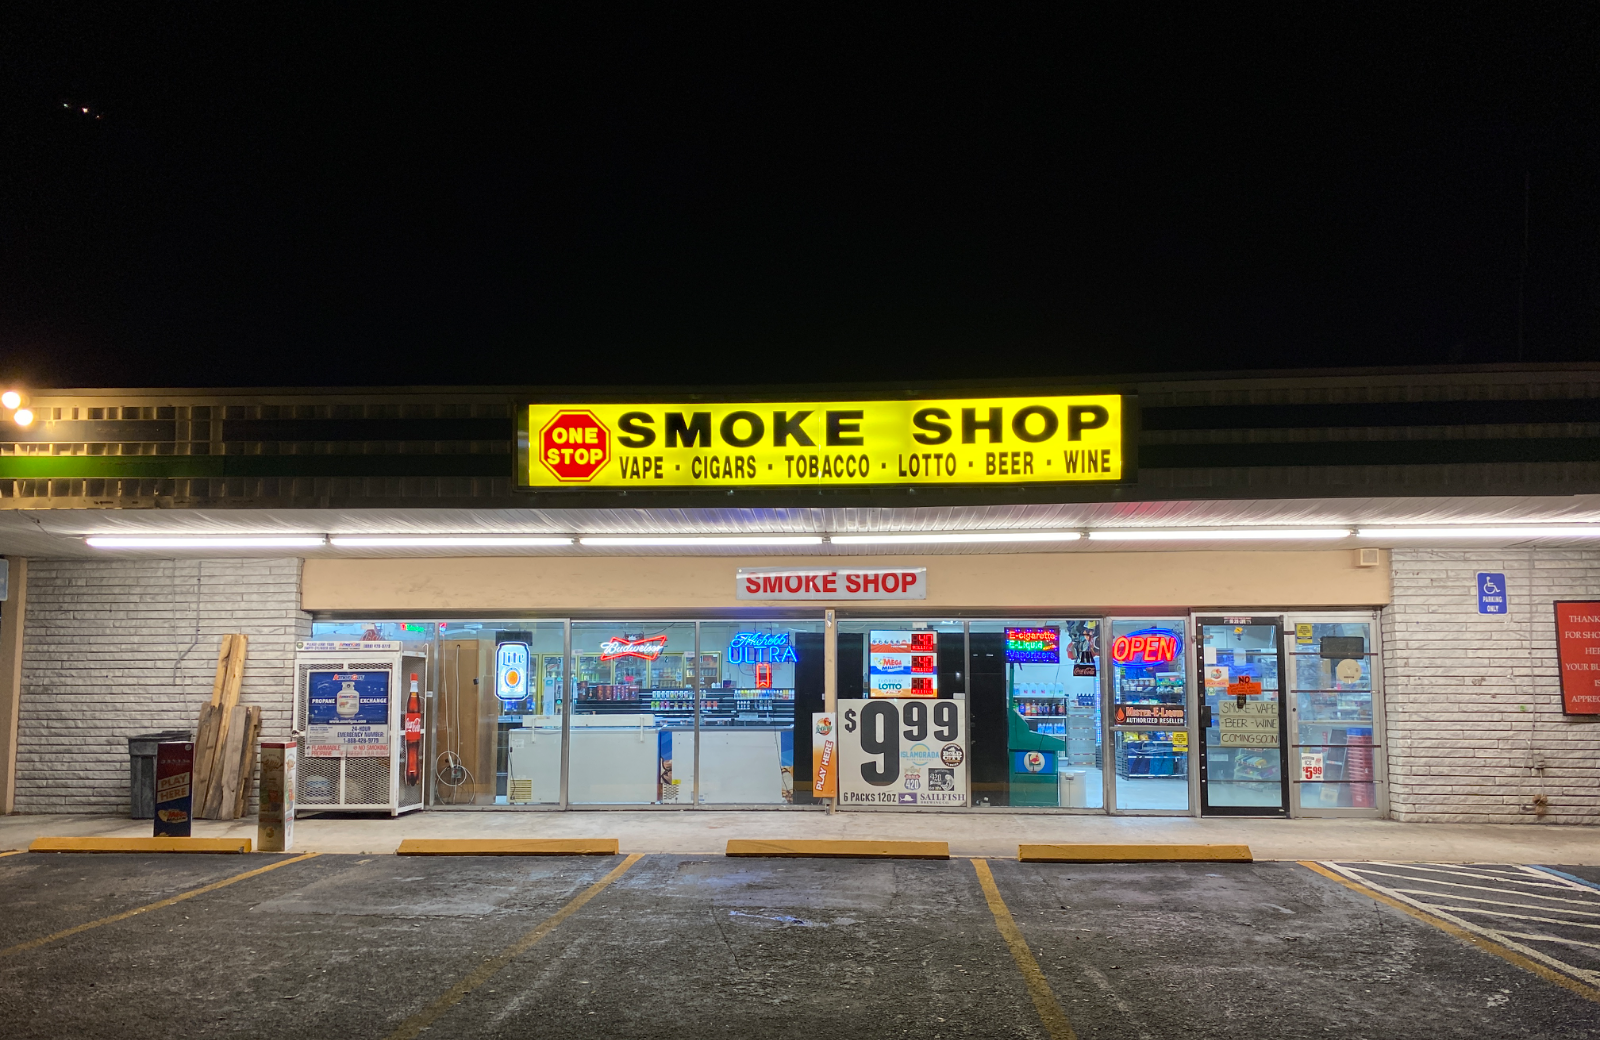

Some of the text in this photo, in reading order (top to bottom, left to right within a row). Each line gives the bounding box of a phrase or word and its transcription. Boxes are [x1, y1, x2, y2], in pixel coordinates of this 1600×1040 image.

[617, 404, 1109, 448] SMOKE SHOP
[552, 427, 599, 444] ONE
[547, 448, 603, 465] STOP
[619, 449, 1111, 480] VAPE CIGARS TOBACCO LOTTO BEER WINE
[745, 572, 917, 594] SMOKE SHOP
[1008, 630, 1056, 640] E-cigarette
[1565, 631, 1581, 639] FOR
[600, 641, 663, 655] Budweiser
[1008, 640, 1043, 650] E-Liquid
[1113, 636, 1176, 661] OPEN
[502, 652, 524, 667] Lite
[728, 645, 799, 664] ULTRA
[883, 658, 902, 666] MEGA
[1238, 676, 1251, 684] NO
[1222, 734, 1278, 743] COMING SOON
[815, 766, 827, 791] PLAY
[822, 740, 834, 766] HERE
[160, 774, 187, 788] PLAY
[906, 779, 918, 790] 420
[160, 788, 187, 800] HERE
[844, 792, 848, 802] 6
[920, 793, 965, 801] SAILFISH
